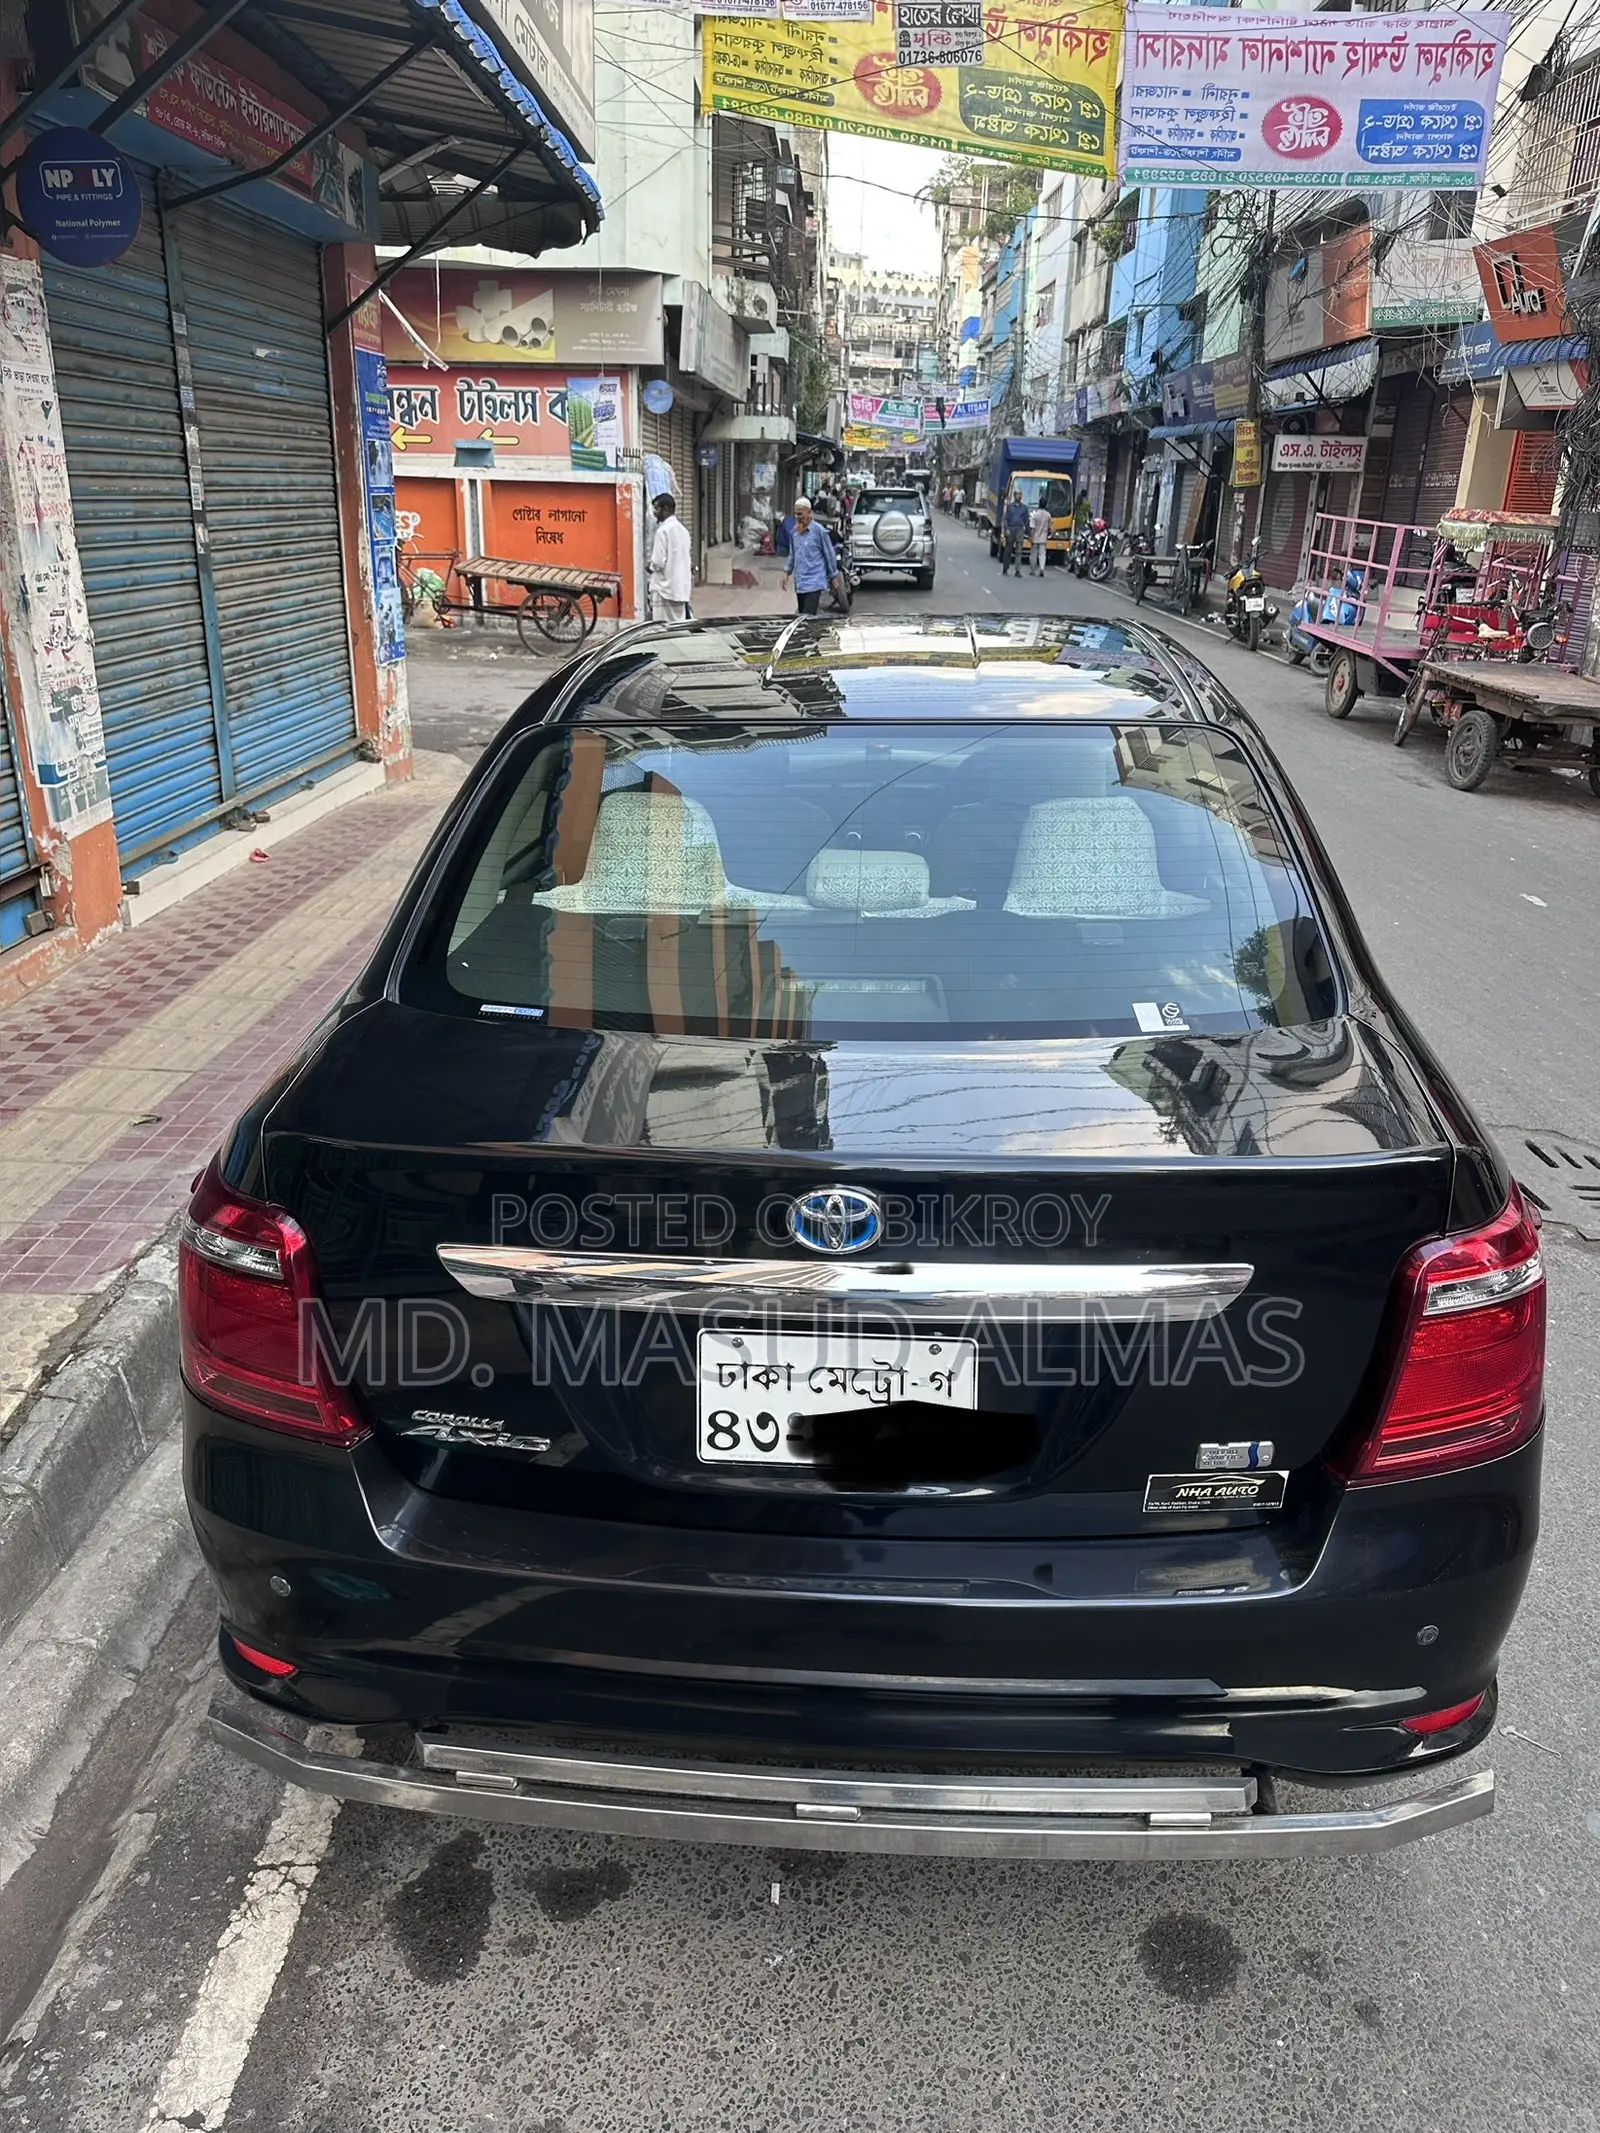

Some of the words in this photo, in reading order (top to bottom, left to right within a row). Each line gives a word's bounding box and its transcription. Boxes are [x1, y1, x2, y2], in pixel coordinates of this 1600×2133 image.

[810, 2, 868, 10] 01677-478156
[900, 5, 942, 26] হাতের
[946, 4, 980, 25] লেখা
[899, 50, 982, 64] 01736-806076
[56, 193, 72, 201] PIPE
[81, 193, 113, 201] FITTINGS
[56, 219, 88, 228] National
[89, 219, 121, 229] Polymer
[455, 377, 542, 424] টাইলস
[548, 508, 588, 523] লাগানো
[535, 526, 565, 545] নিষেধ
[716, 1361, 796, 1394] ঢাকা
[411, 1409, 505, 1431] COROLLA
[1176, 1487, 1212, 1498] NHA
[1213, 1485, 1259, 1496] AUTO
